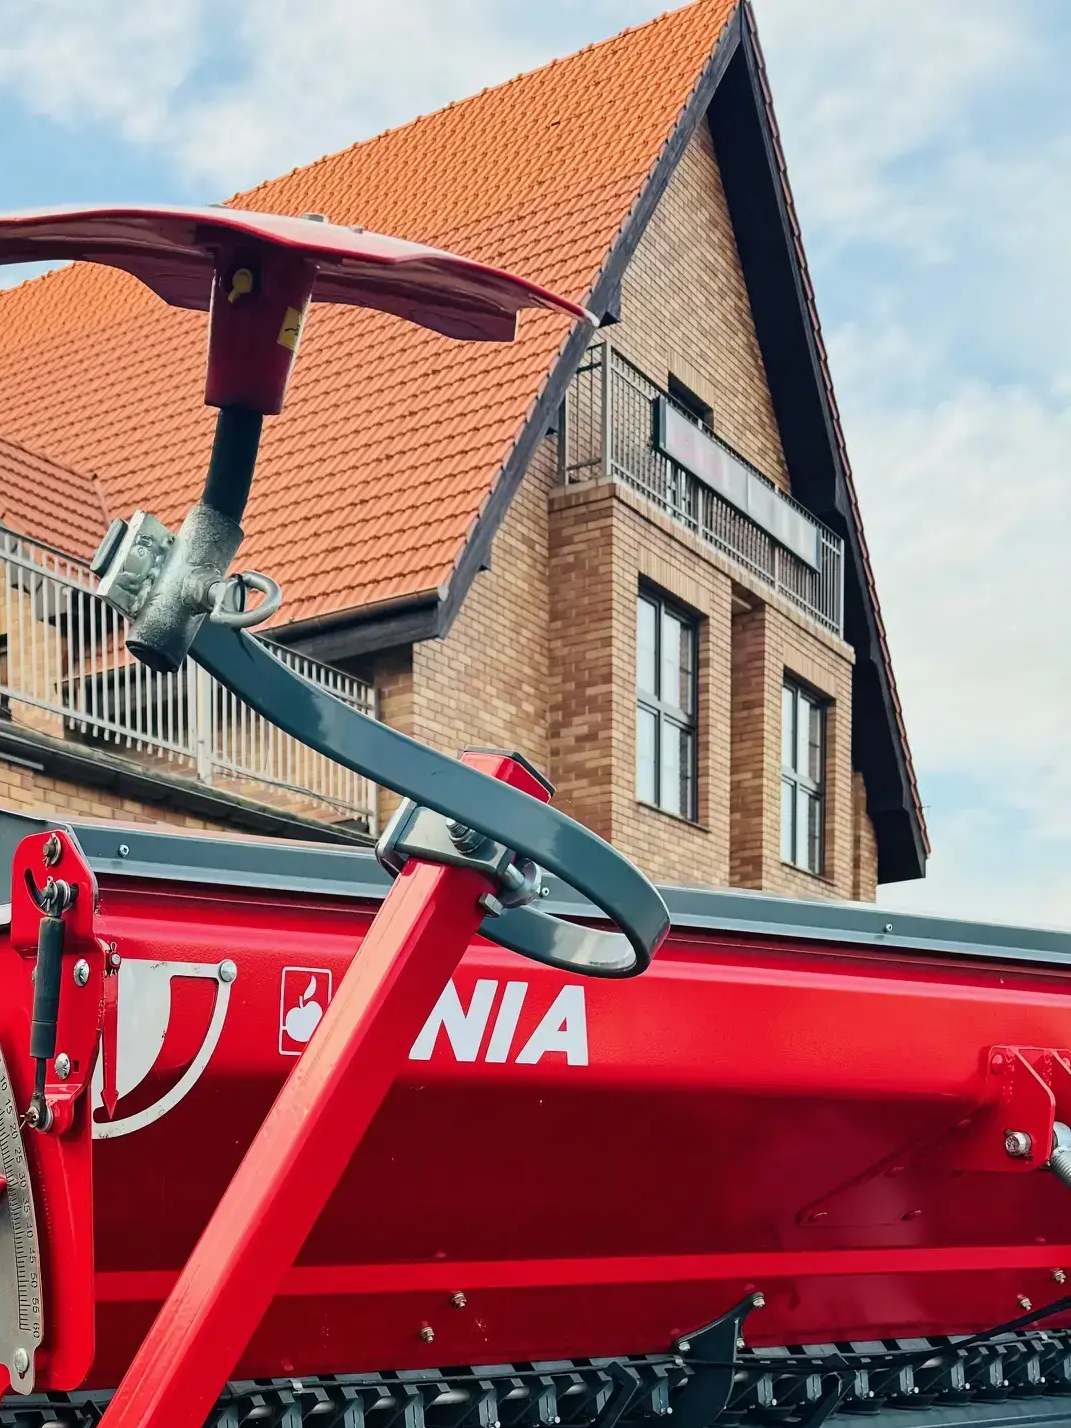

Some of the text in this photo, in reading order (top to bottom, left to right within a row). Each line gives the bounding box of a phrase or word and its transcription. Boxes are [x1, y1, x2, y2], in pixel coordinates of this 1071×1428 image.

[409, 978, 589, 1067] NIA
[0, 1075, 8, 1091] 10
[5, 1098, 13, 1115] 15
[9, 1122, 19, 1140] 20
[14, 1147, 23, 1164] 25
[18, 1172, 27, 1188] 30
[23, 1197, 31, 1214] 35
[30, 1272, 38, 1289] 50
[31, 1297, 40, 1314] 55
[33, 1322, 40, 1339] 60
